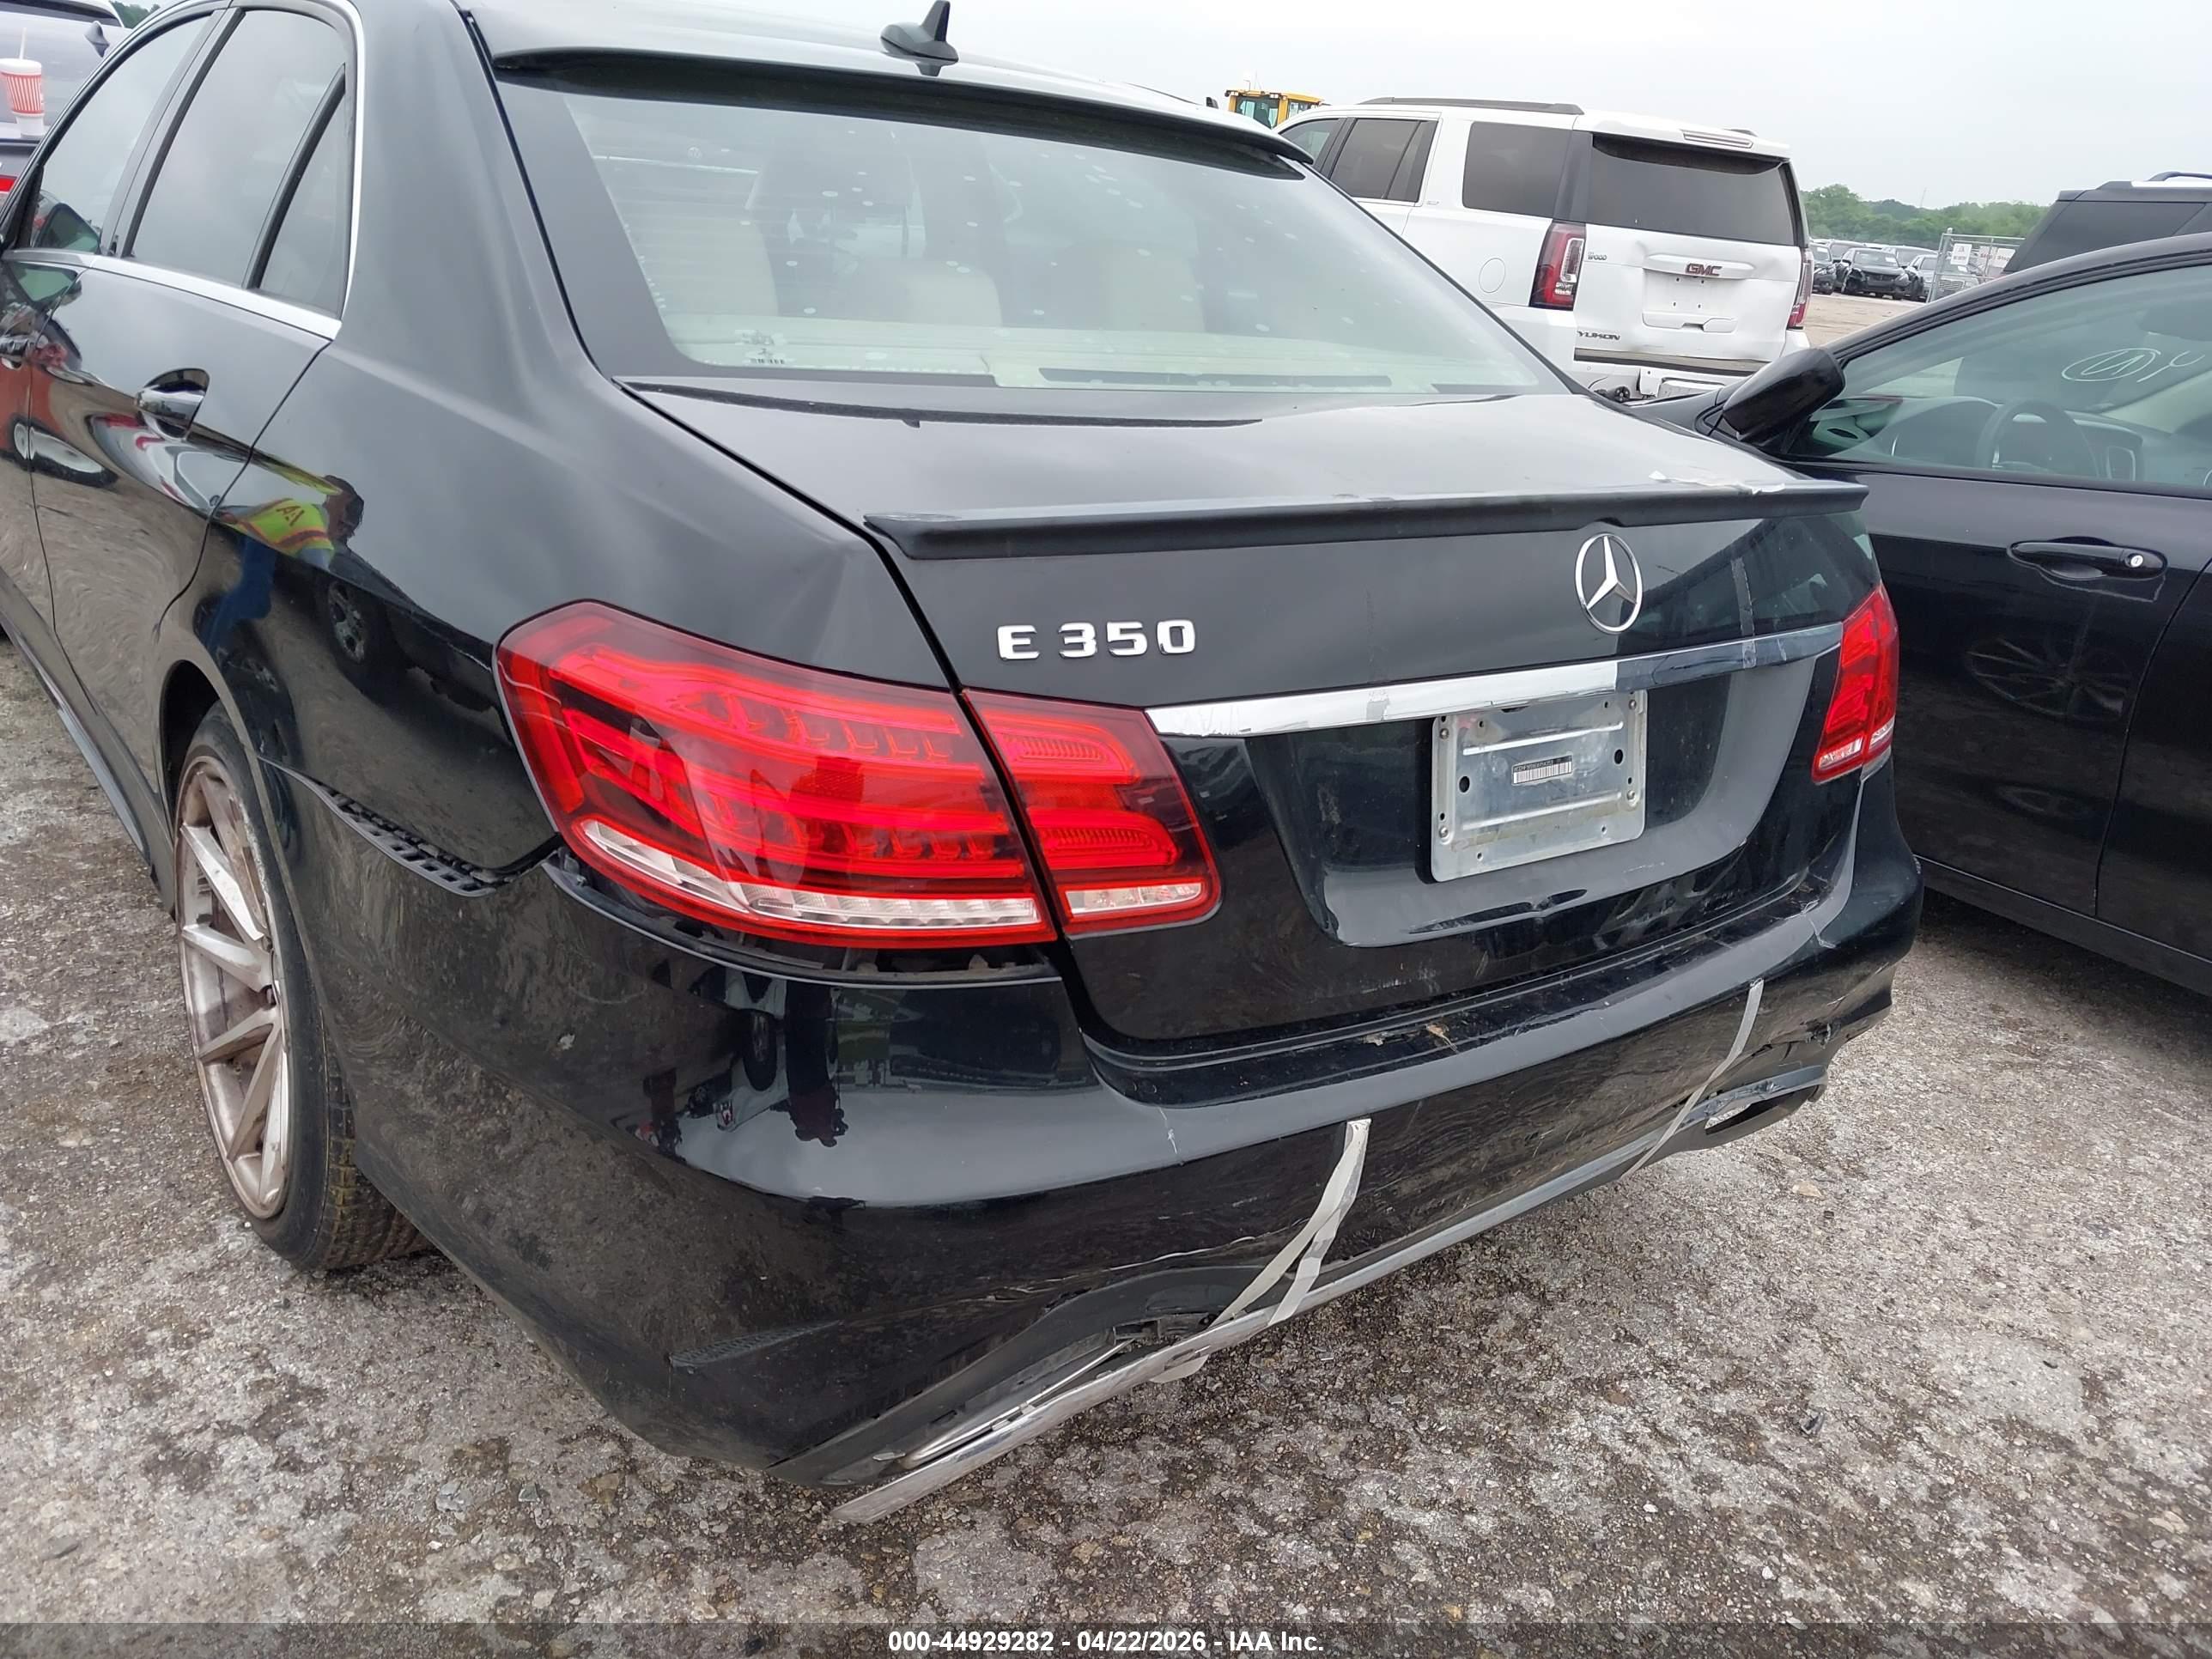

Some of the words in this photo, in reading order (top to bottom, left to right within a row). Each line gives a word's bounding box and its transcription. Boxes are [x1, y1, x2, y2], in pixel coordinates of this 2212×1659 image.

[1686, 263, 1723, 276] GMC
[1577, 331, 1620, 341] YUKON
[997, 624, 1040, 661] E
[1058, 619, 1195, 659] 350
